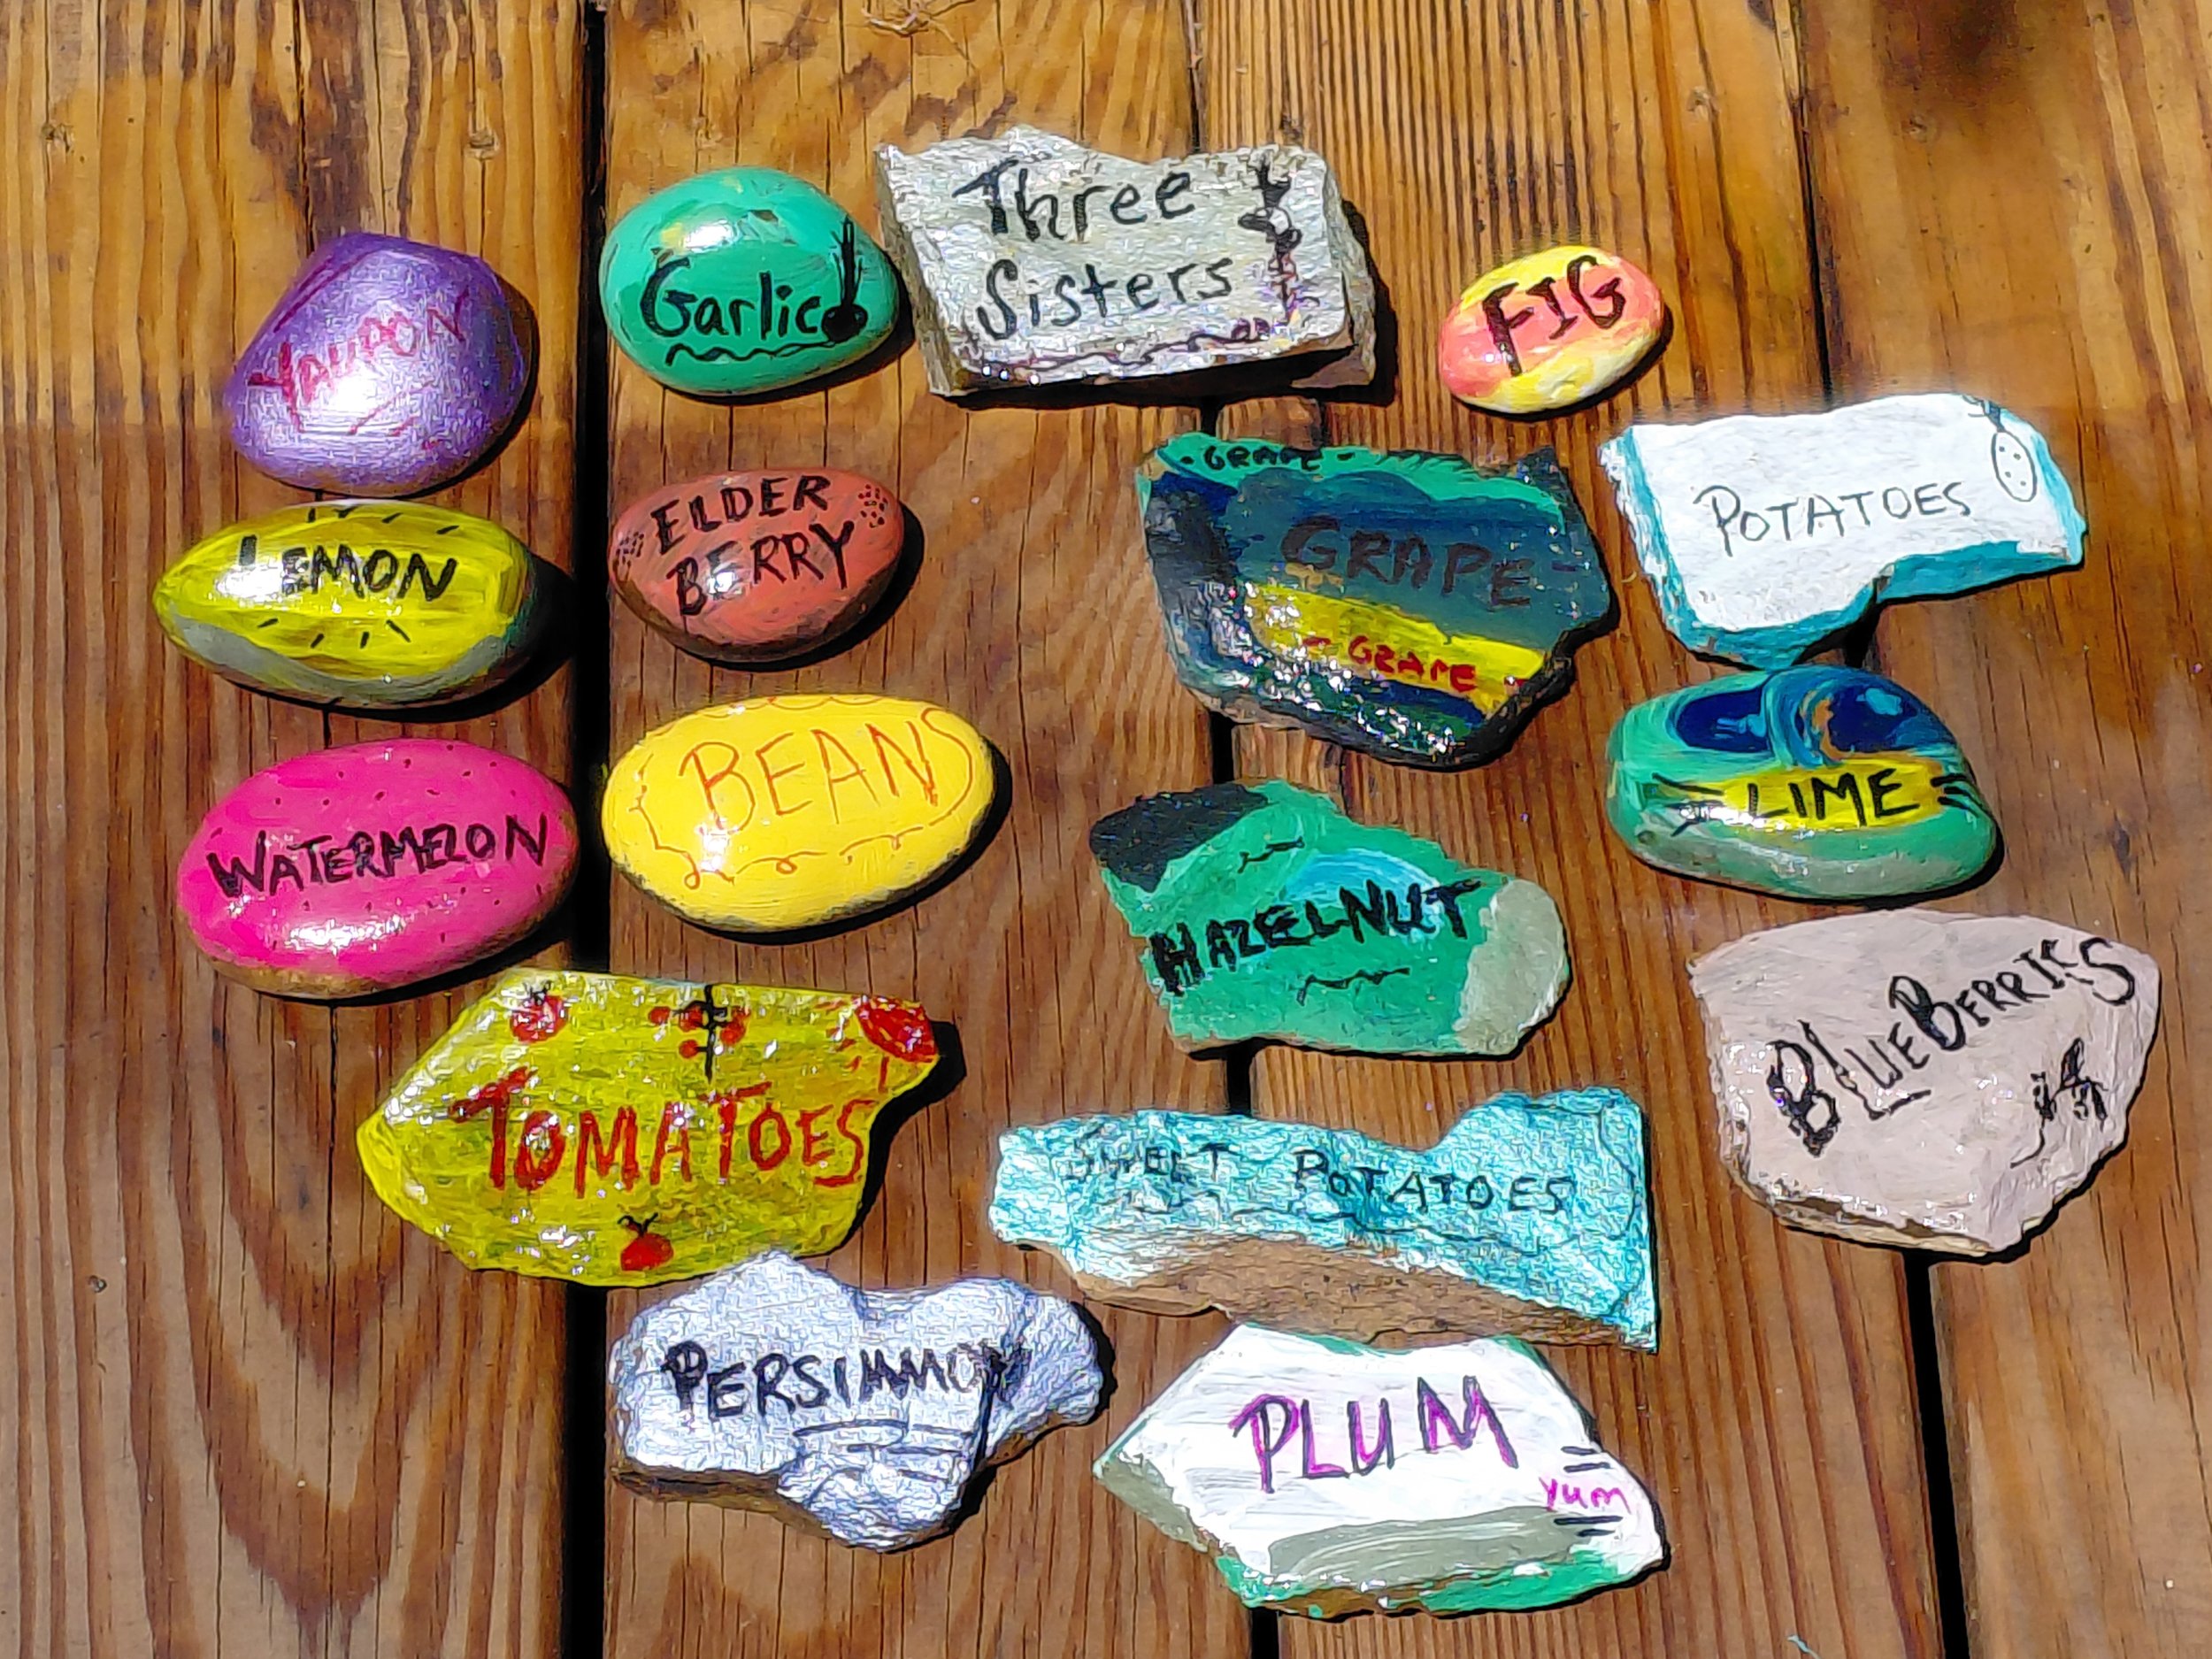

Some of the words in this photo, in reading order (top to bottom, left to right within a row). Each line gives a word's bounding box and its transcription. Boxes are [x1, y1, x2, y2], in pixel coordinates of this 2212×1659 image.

[951, 157, 1196, 243] Three
[639, 257, 821, 341] Garlic
[977, 257, 1233, 341] Sisters
[1481, 254, 1629, 378] FIG
[1203, 444, 1325, 472] GRAPE
[649, 474, 832, 556] ELDER
[1694, 480, 1972, 557] POTATOES
[238, 534, 458, 603] LEMON
[666, 520, 855, 617] BERRY
[1280, 514, 1535, 612] GRAPE
[1348, 634, 1479, 693] GRAPE
[678, 706, 974, 835] BEANS
[1746, 767, 1921, 827] LIME
[205, 812, 548, 899] WATERMELON
[1150, 878, 1484, 997] HAZELNUT
[449, 1065, 877, 1200] TOMATOES
[1056, 1121, 1241, 1187] SWEET
[1293, 1148, 1575, 1215] POTATOES
[660, 1339, 1033, 1421] PERSIMMON
[1227, 1374, 1519, 1495] PLUM
